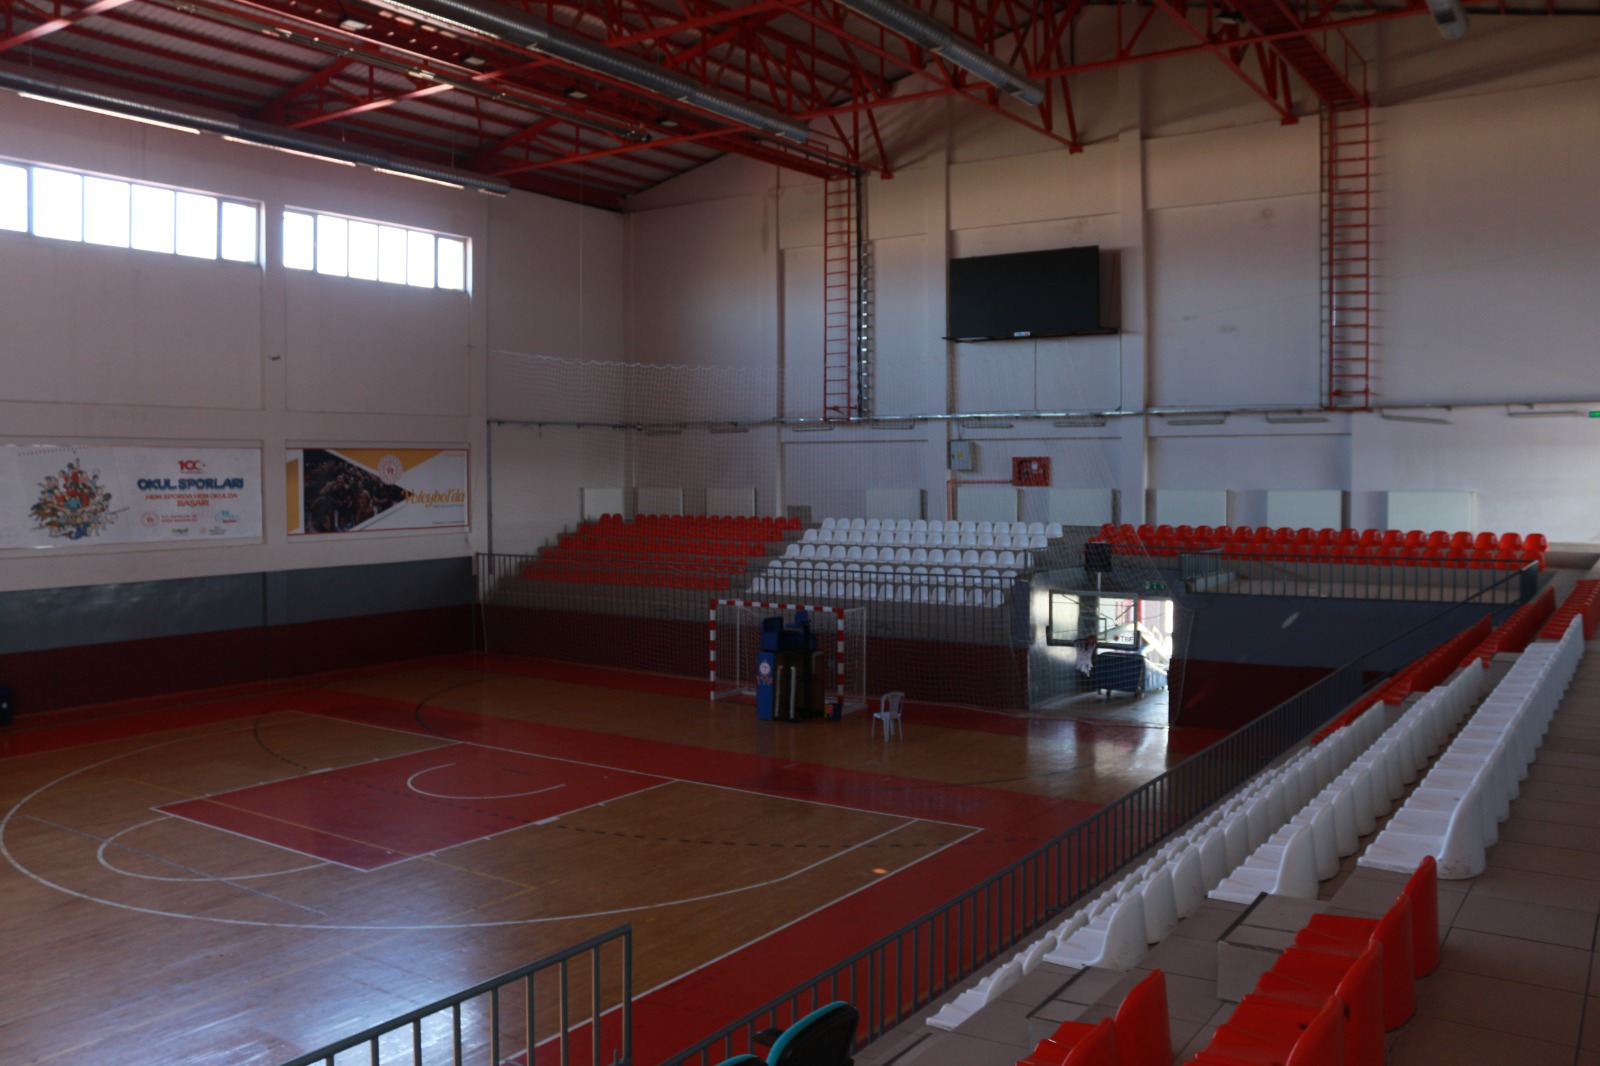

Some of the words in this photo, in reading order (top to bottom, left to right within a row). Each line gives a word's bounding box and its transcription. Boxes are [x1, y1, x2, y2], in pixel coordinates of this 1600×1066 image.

[137, 478, 177, 490] OKUL
[178, 478, 244, 490] SPORLARI
[400, 489, 466, 507] Voleybol'da
